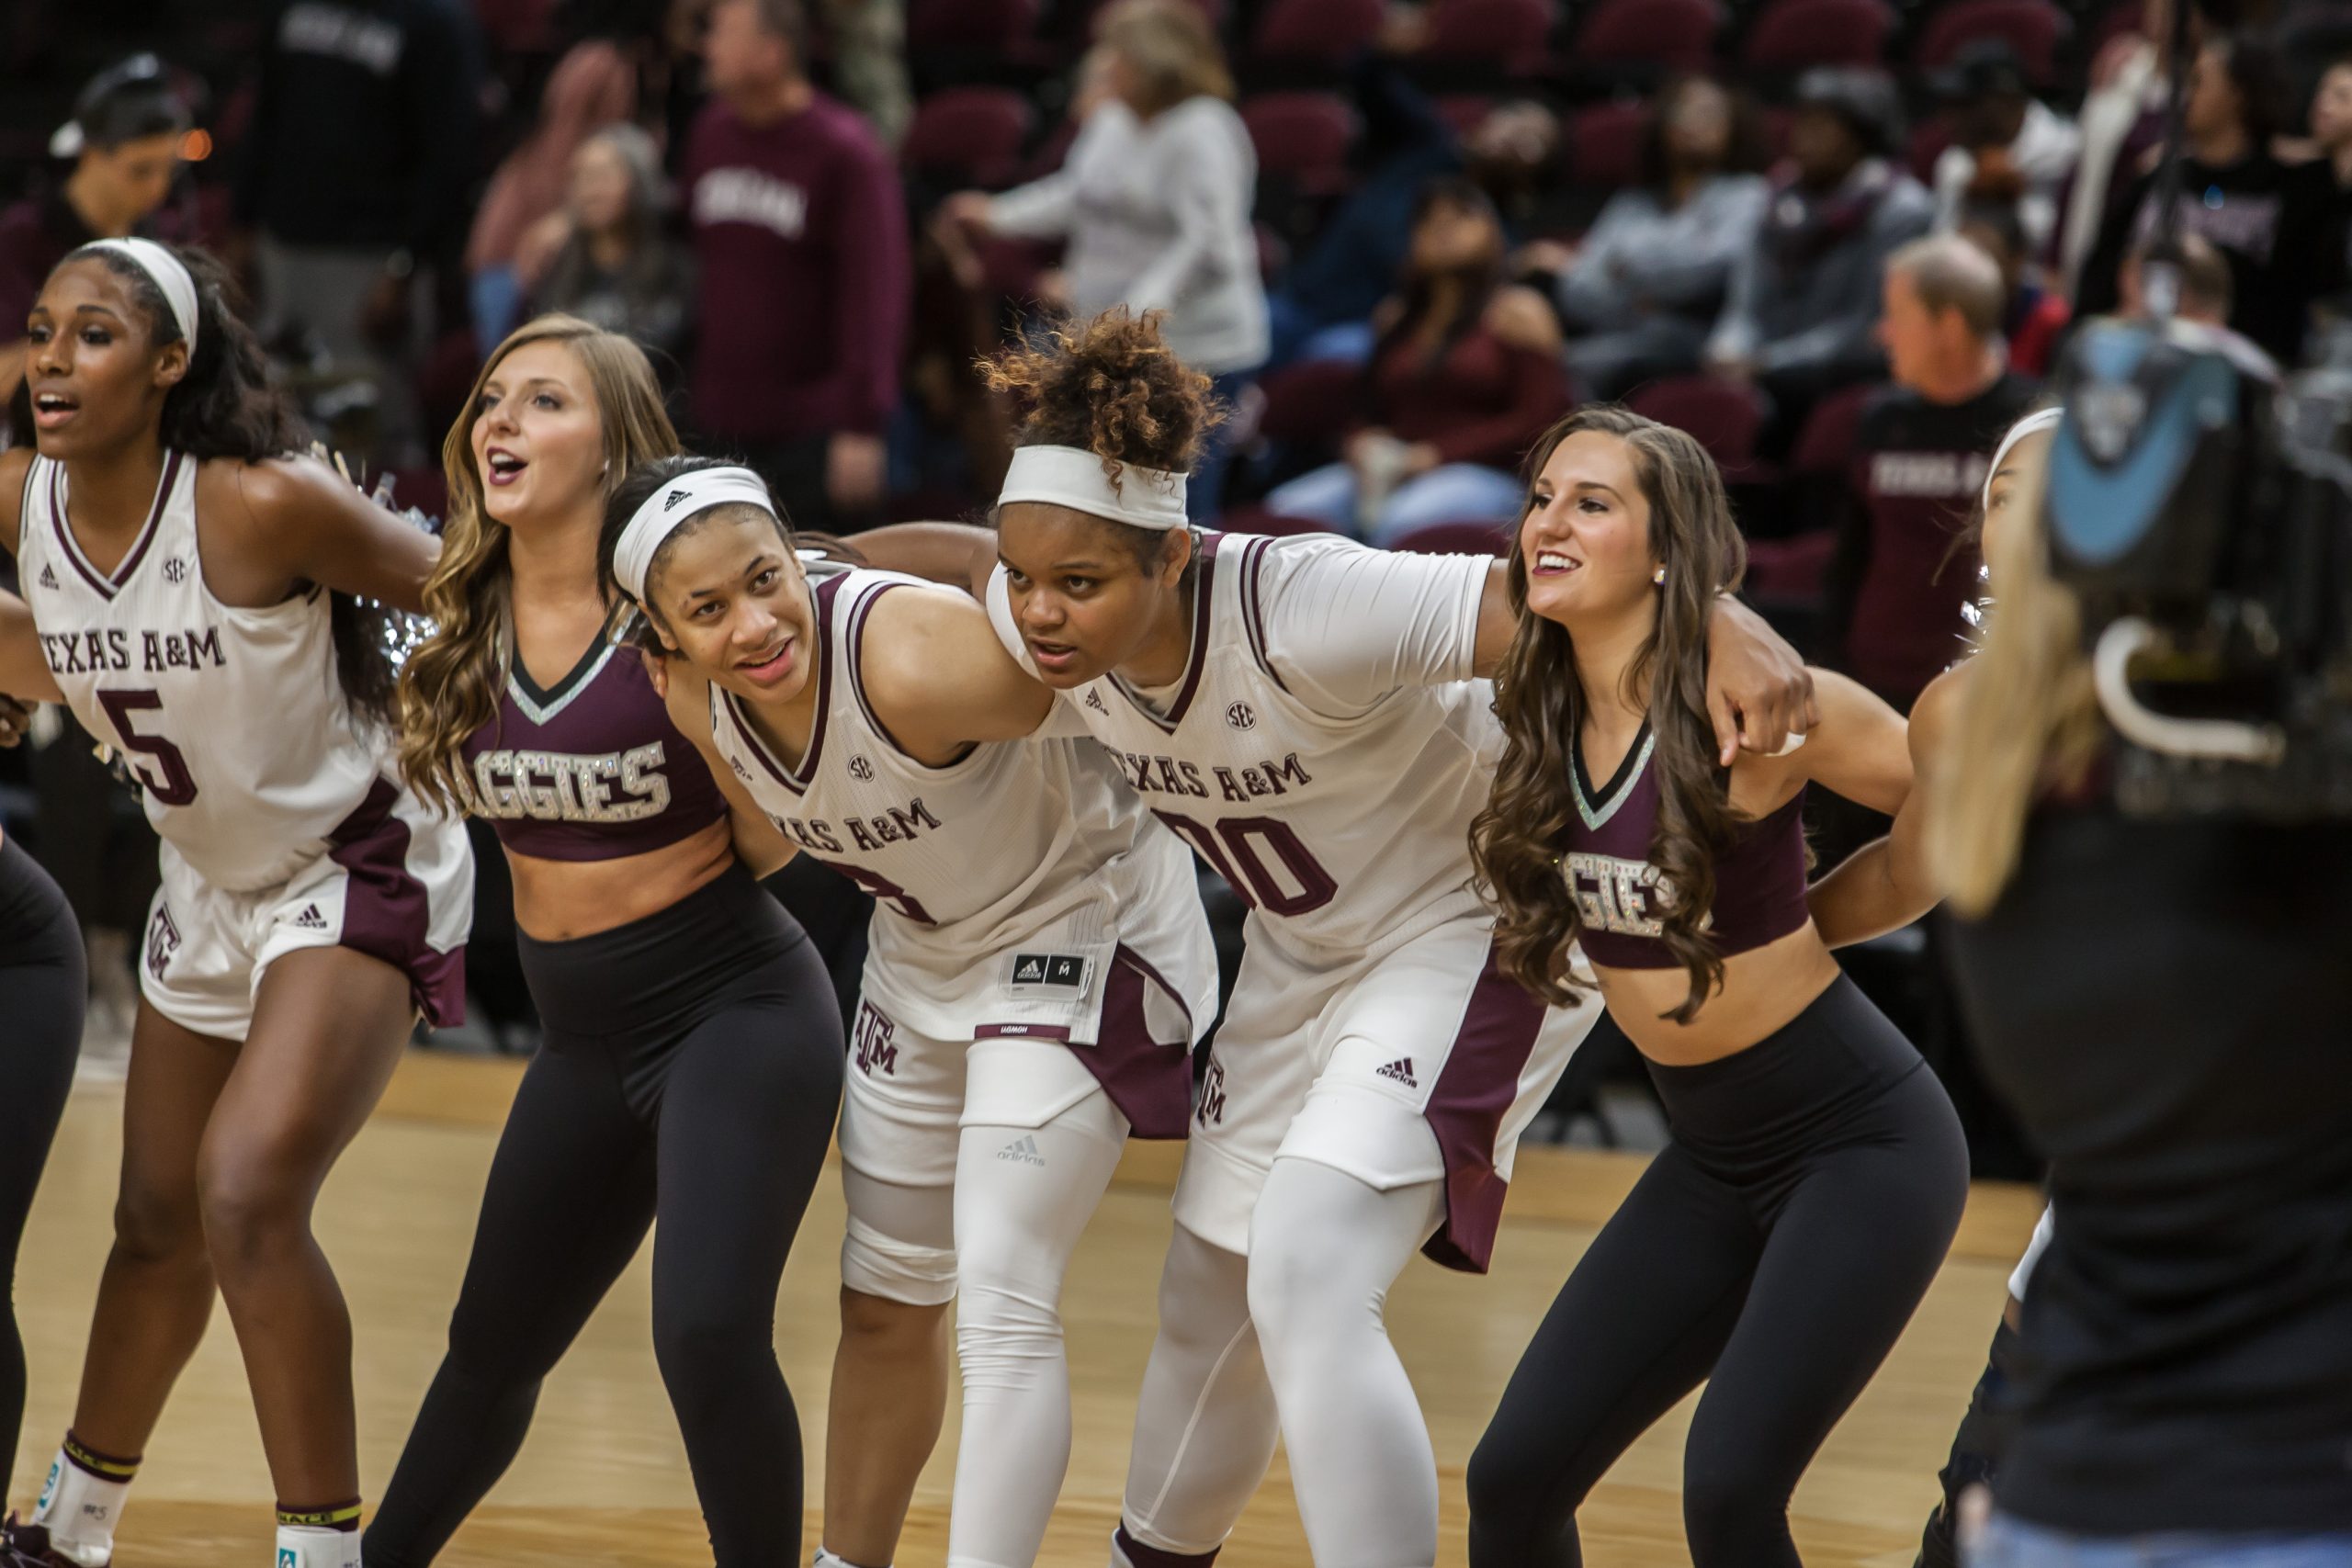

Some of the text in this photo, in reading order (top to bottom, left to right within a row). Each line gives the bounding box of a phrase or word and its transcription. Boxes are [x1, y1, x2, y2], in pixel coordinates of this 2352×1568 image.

[141, 626, 226, 671] A&M
[1228, 704, 1255, 728] SEC
[96, 689, 198, 806] 5
[1212, 752, 1311, 802] A&M
[843, 797, 942, 852] A&M
[1059, 964, 1070, 976] M
[1375, 1066, 1419, 1089] adidas
[996, 1150, 1046, 1168] adidas
